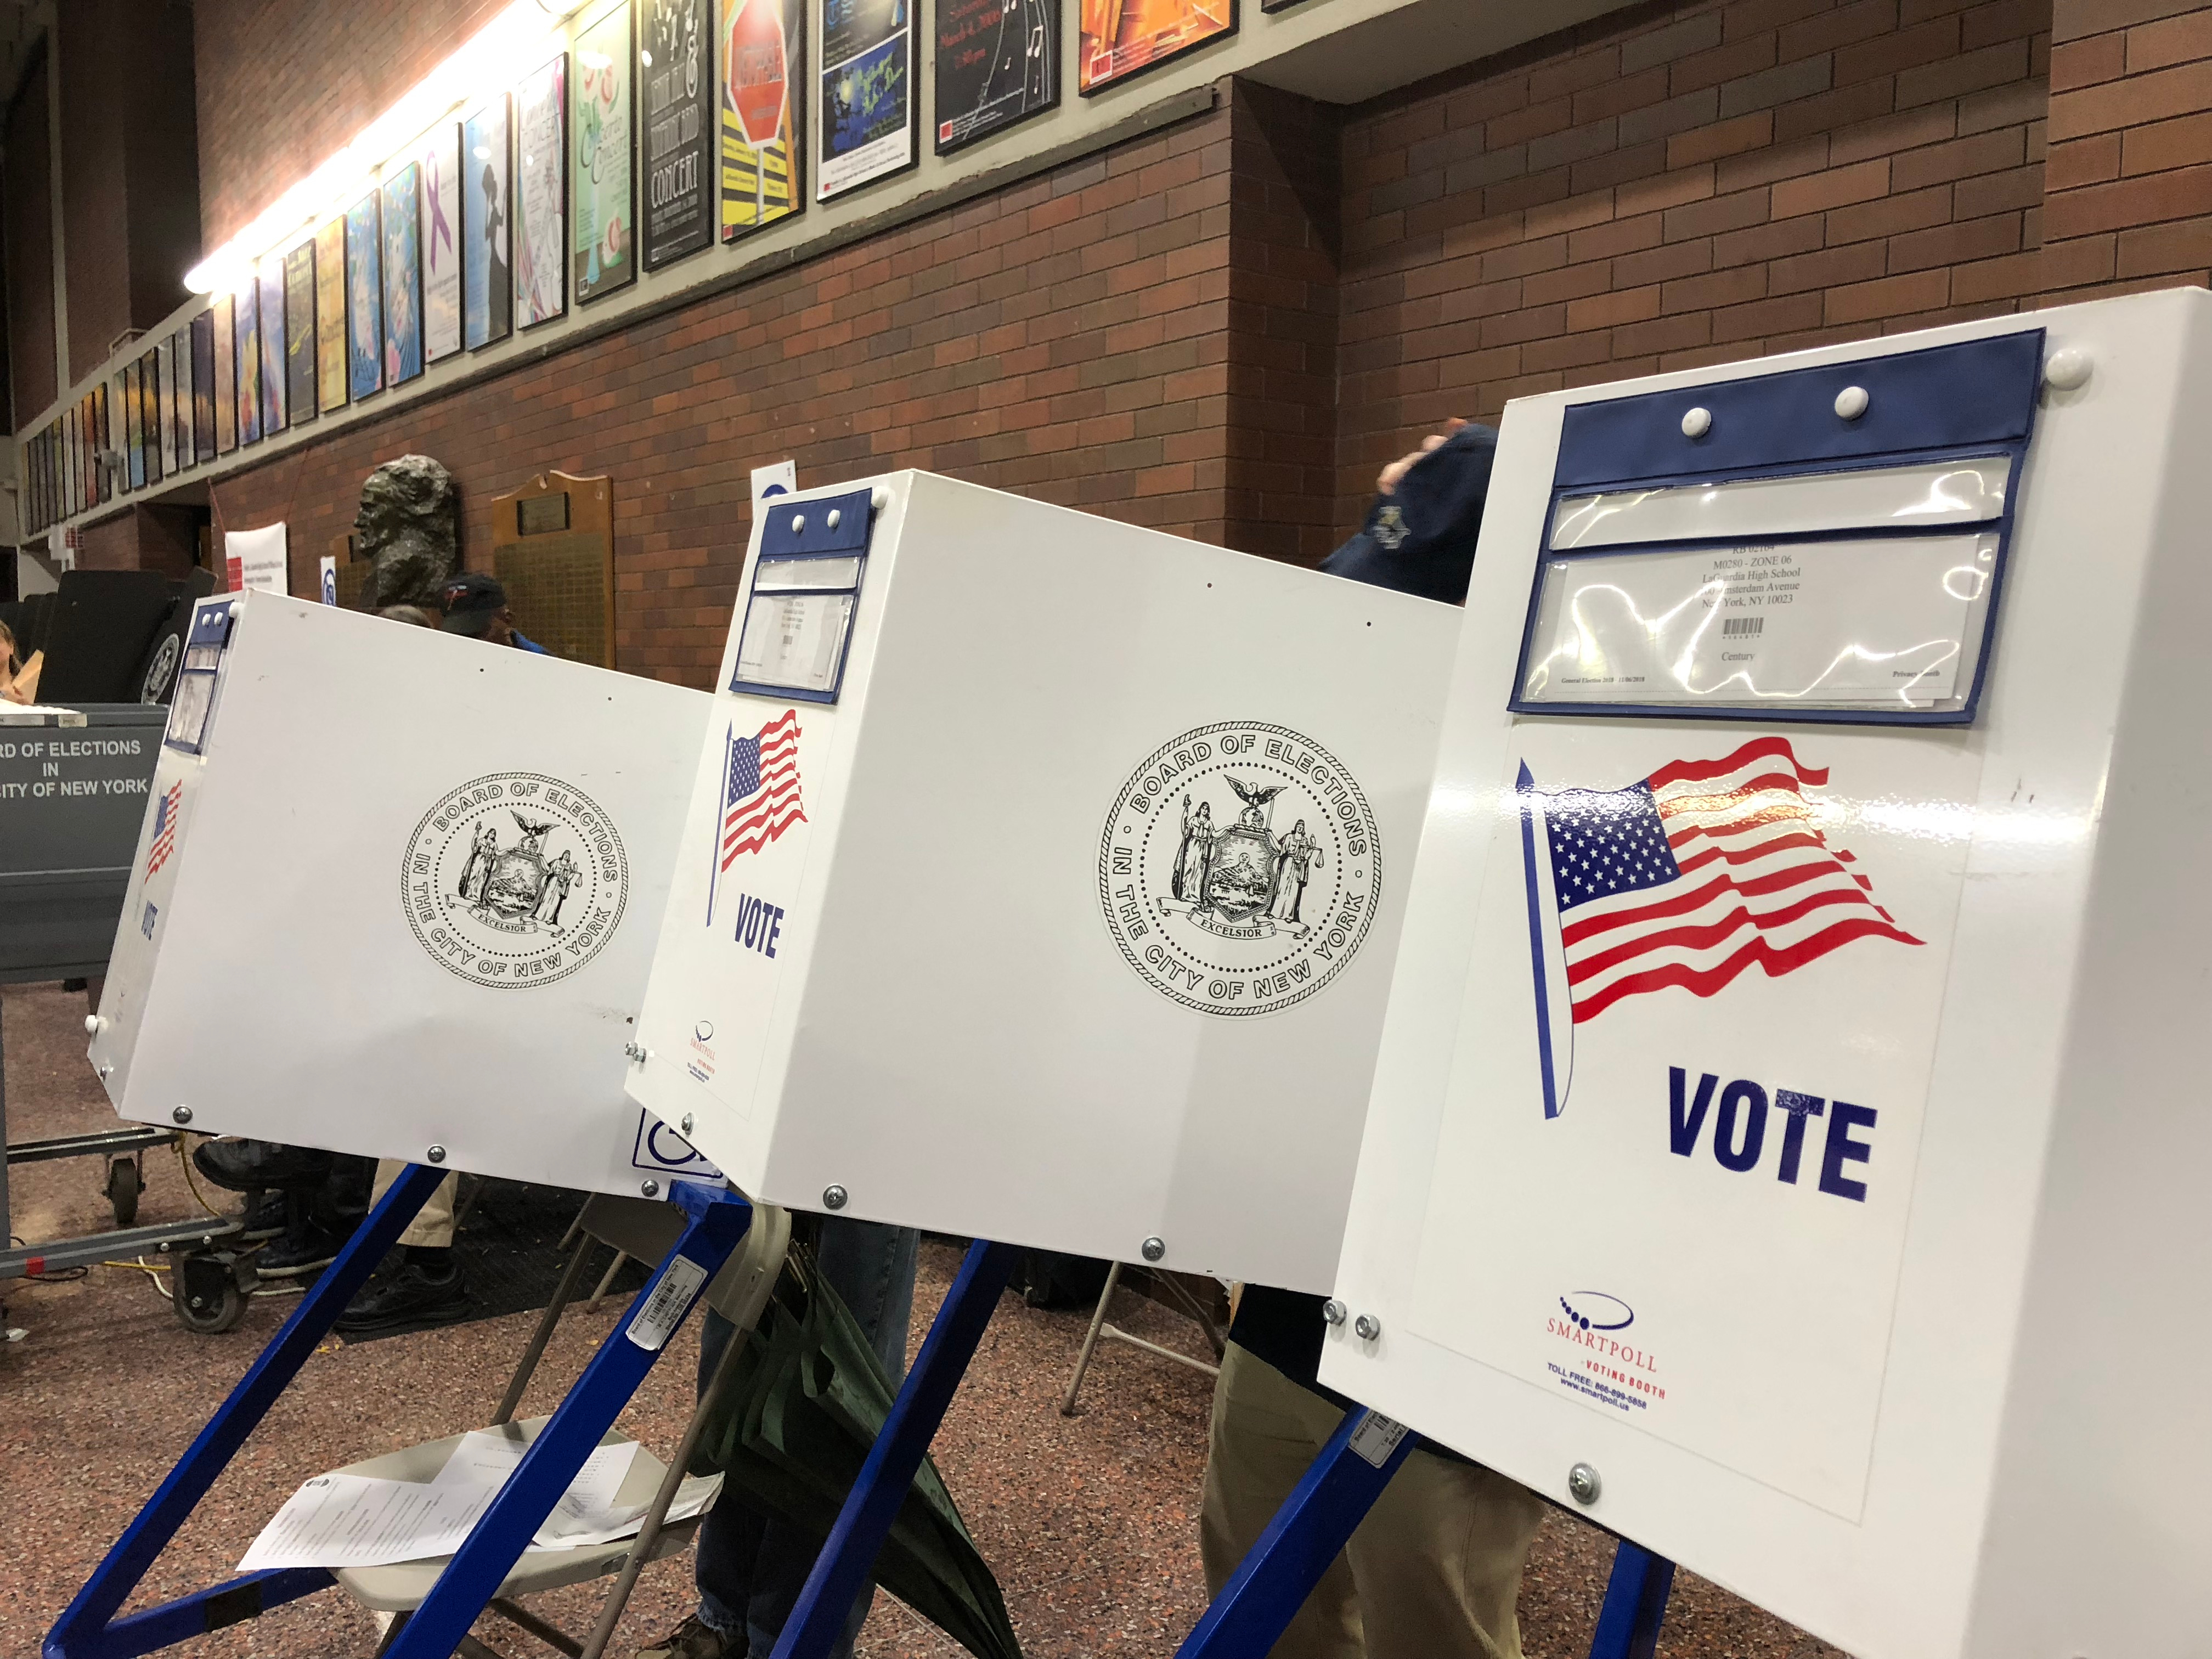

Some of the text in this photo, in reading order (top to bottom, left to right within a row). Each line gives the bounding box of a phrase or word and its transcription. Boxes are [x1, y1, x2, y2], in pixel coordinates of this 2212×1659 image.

[651, 150, 699, 208] CONCERT
[1713, 559, 1743, 570] M0280
[1750, 556, 1779, 567] ZONE
[1781, 555, 1792, 565] 06
[1747, 570, 1768, 581] High
[1770, 567, 1801, 578] School
[1720, 584, 1764, 595] msterdam
[1766, 583, 1801, 592] Avenue
[1702, 594, 1793, 608] Ne York, NY 10023
[1722, 652, 1755, 662] Century
[21, 742, 44, 758] OF
[49, 740, 141, 757] ELECTIONS
[43, 762, 59, 777] IN
[0, 778, 148, 798] ITY OF NEW YORK
[1130, 735, 1367, 856] BOARD OF ELECTIONS
[433, 782, 618, 882] BOARD OF ELECTIONS
[413, 854, 611, 977] IN THE CITY OF NEW YORK
[478, 913, 527, 932] EXCELSIOR
[1113, 847, 1365, 1000] IN THE CITY OF NEW YORK
[735, 893, 785, 959] VOTE
[1200, 919, 1263, 938] EXCELSIOR
[691, 1038, 715, 1060] SMARTPOLL
[1669, 1065, 1878, 1203] VOTE
[631, 1323, 640, 1334] Board
[1547, 1318, 1656, 1373] SMARTPOLL
[1548, 1362, 1567, 1377] TOLL
[1586, 1359, 1666, 1400] VOTING BOOTH
[1561, 1378, 1629, 1412] www.smartpoll.us
[1389, 1428, 1403, 1446] Serial
